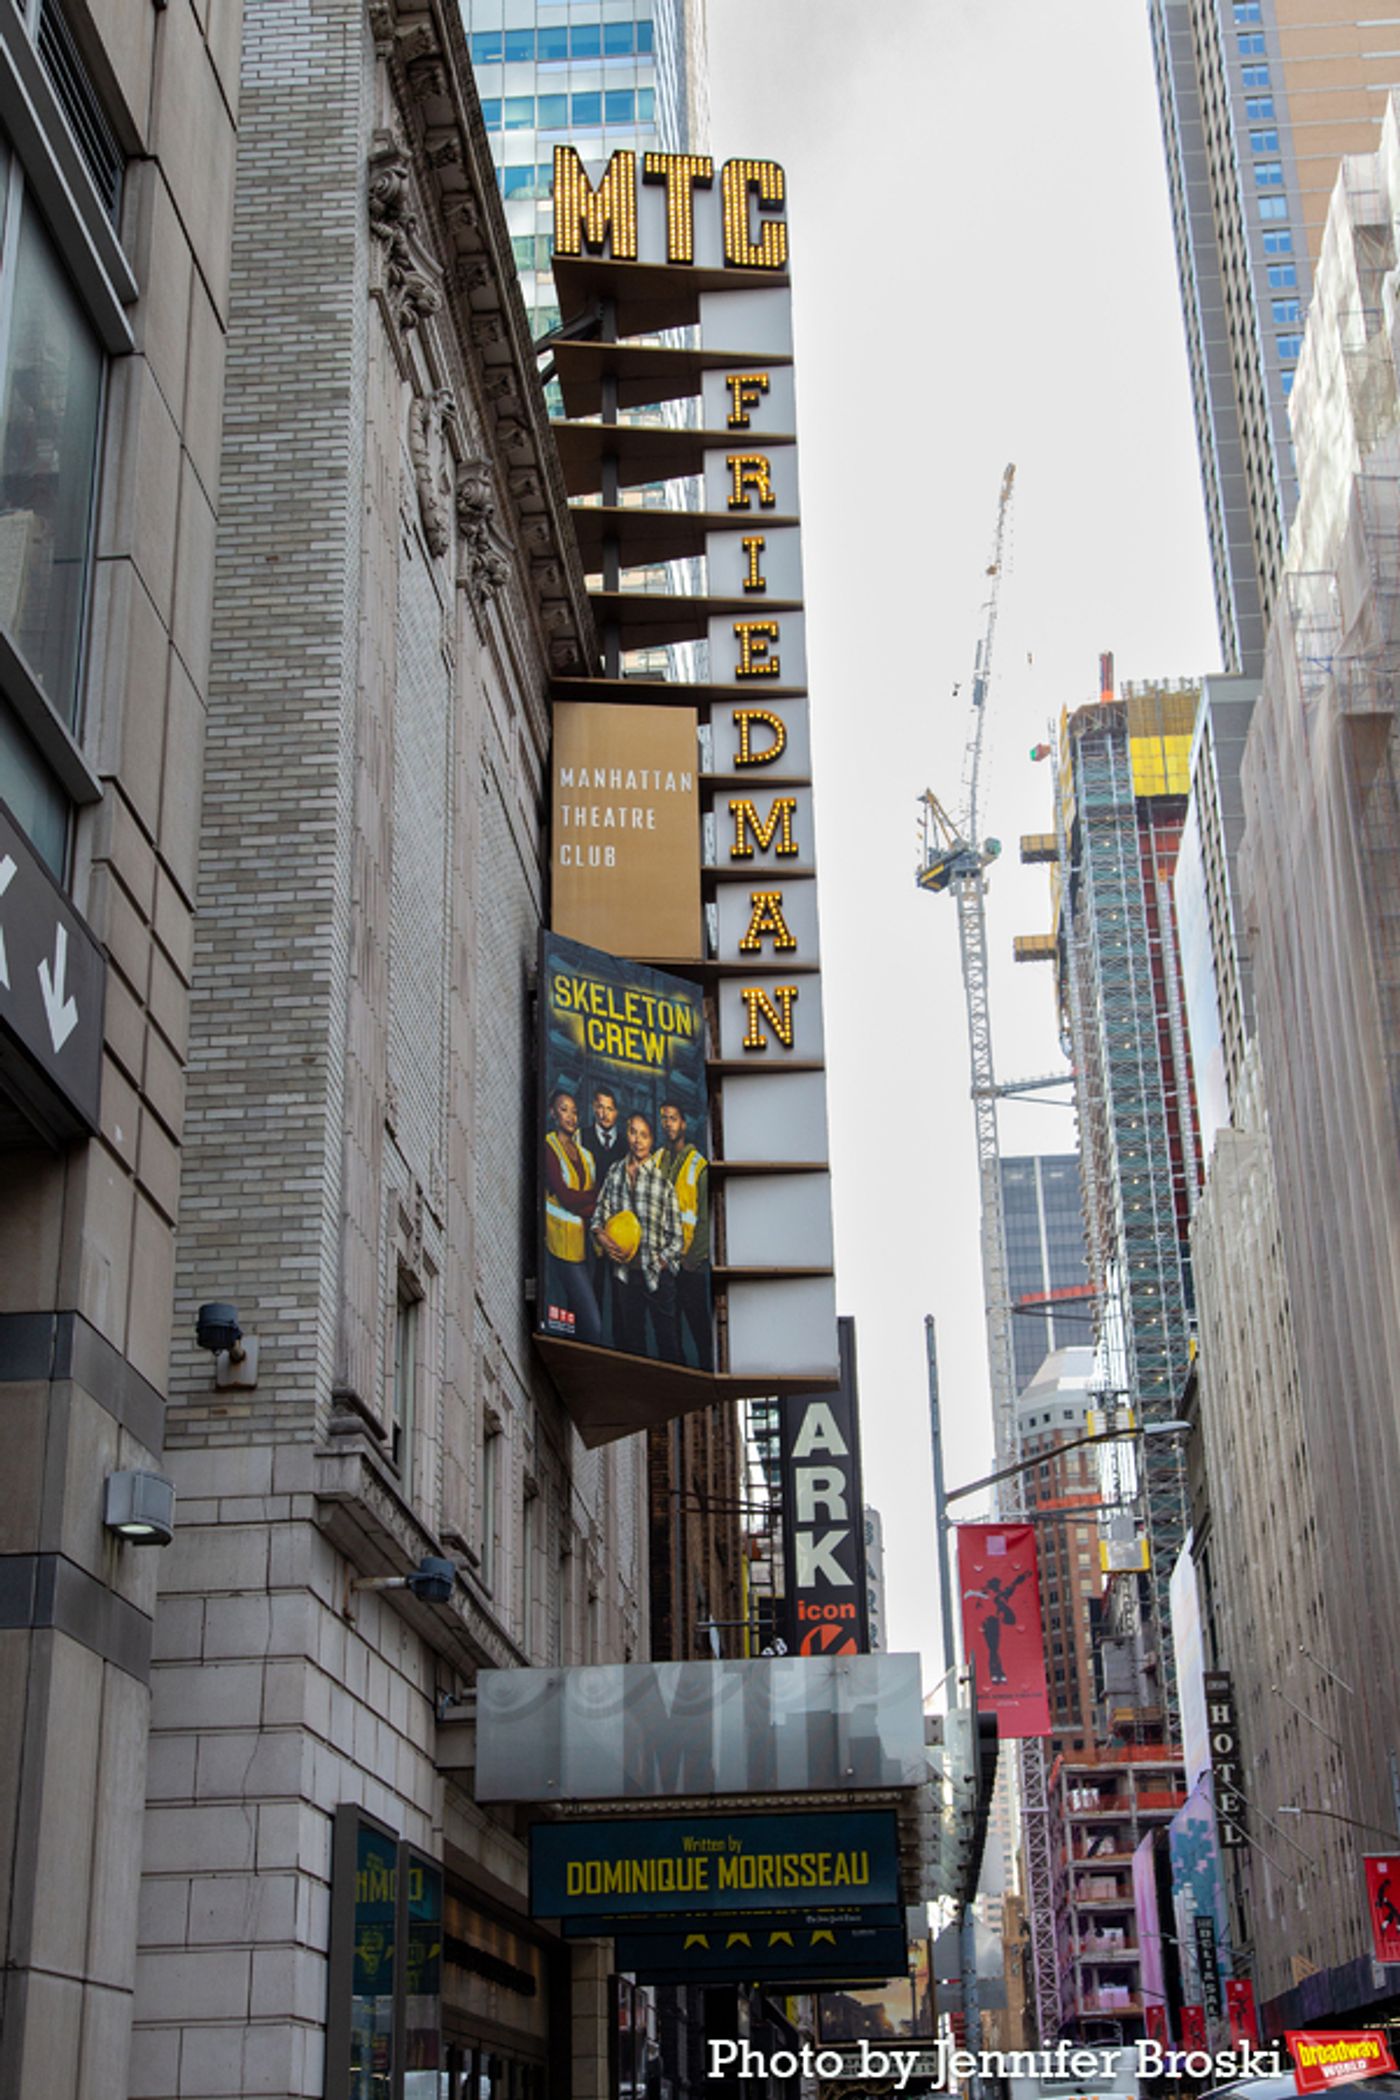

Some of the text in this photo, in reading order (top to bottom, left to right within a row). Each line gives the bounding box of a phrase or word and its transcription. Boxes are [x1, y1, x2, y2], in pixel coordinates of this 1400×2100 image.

[553, 145, 788, 269] MTC
[726, 372, 798, 1050] FRIEDMAN
[560, 768, 692, 792] MANHATTAN
[560, 805, 656, 829] THEATRE
[560, 845, 616, 868] CLUB
[554, 975, 693, 1036] SKELETON
[587, 1019, 666, 1065] CREW
[798, 1600, 856, 1620] icon
[1210, 1704, 1242, 1844] HOTEL
[682, 1834, 742, 1853] Written by
[566, 1851, 869, 1896] DOMINIQUE MORISSEAU
